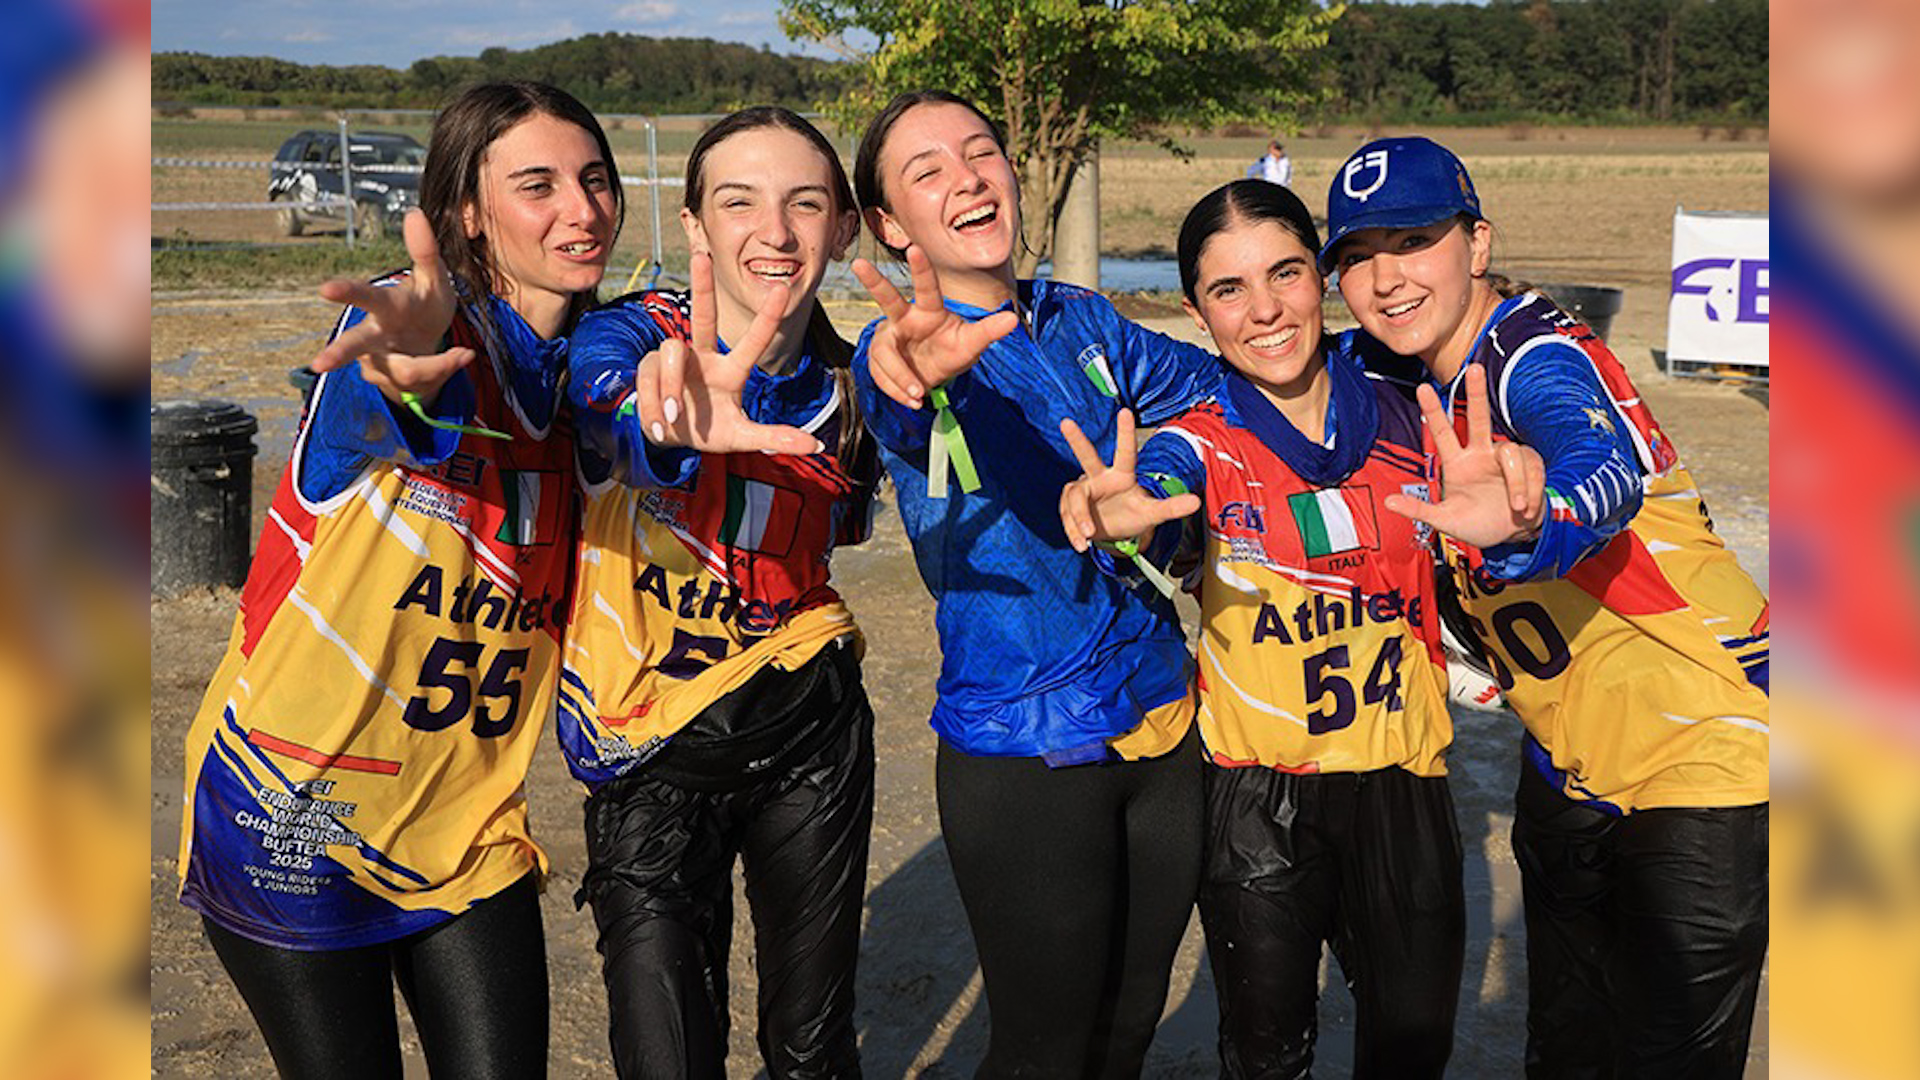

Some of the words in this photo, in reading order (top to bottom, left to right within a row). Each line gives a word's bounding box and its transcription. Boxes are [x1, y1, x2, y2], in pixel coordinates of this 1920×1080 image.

[1328, 552, 1366, 571] ITALY
[1253, 586, 1422, 645] Athlete
[402, 635, 530, 738] 55
[1303, 634, 1405, 735] 54
[234, 809, 362, 847] CHAMPIONSHIP
[271, 808, 333, 829] WORLD
[262, 834, 328, 857] BUFTEA
[269, 851, 313, 871] 2025
[242, 864, 286, 882] YOUNG
[263, 880, 319, 895] JUNIORS
